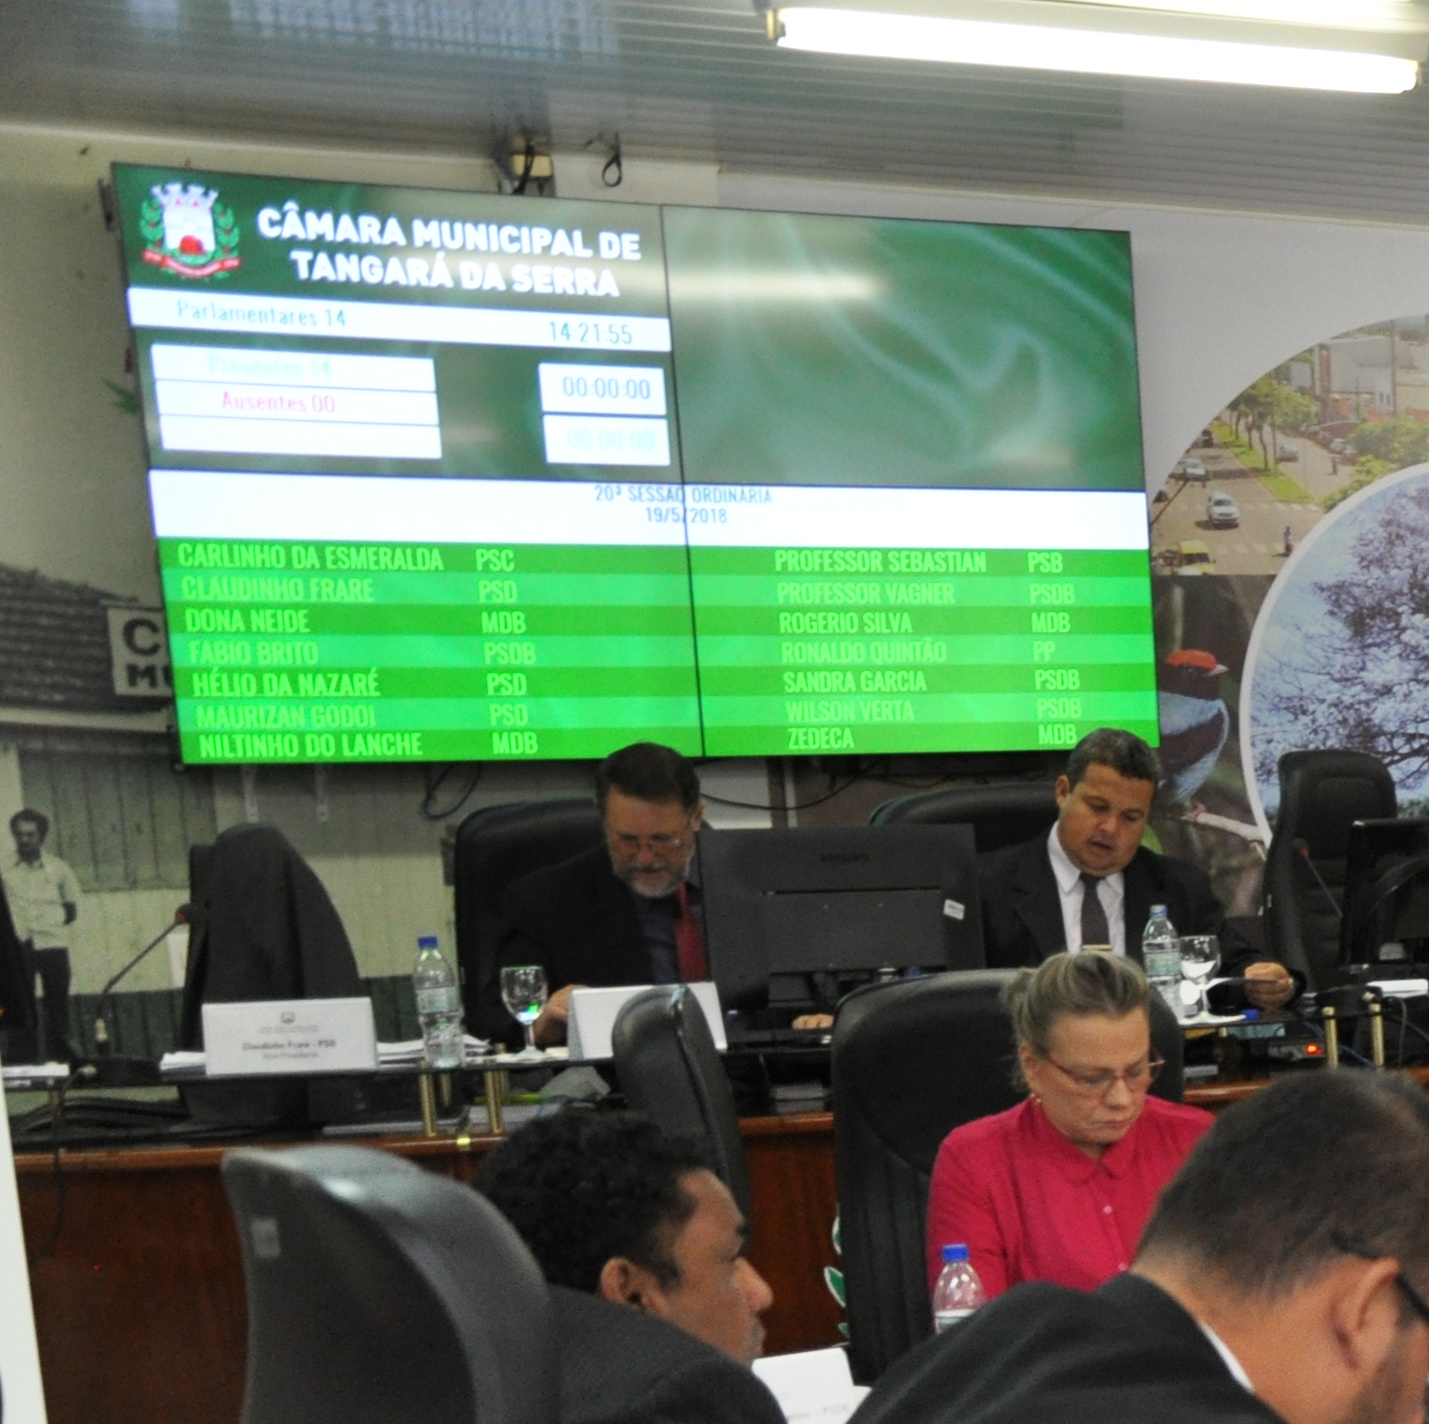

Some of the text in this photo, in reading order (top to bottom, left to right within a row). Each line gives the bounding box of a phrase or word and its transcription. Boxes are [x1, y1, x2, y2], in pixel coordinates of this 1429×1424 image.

[258, 201, 641, 261] CÂMARA MUNICIPAL DE
[290, 250, 620, 297] TANGARÁ DA SERRA
[177, 300, 346, 328] Parlamentares 14
[549, 320, 633, 346] 14:21:55
[562, 375, 651, 400] 00:00:00
[222, 390, 336, 414] Ausentes 00
[645, 507, 727, 524] 19/5/2018
[178, 543, 515, 572] CARLINHO DA ESMERALDA PSC
[774, 549, 1063, 574] PROFESSOR SEBASTIAN PSB
[181, 575, 518, 603] CLAUDINHO FRARE PSD
[776, 582, 1076, 605] PROFESSOR VAGNER PSDB
[185, 608, 526, 635] DONA NEIDE MDB
[863, 611, 913, 634] SILVA
[1031, 611, 1071, 634] MDB
[257, 641, 319, 665] BRITO
[484, 642, 536, 666] PSDB
[781, 641, 865, 664] RONALDO
[1033, 640, 1056, 662] PP
[192, 667, 527, 697] HÉLIO DA NAZARÉ PSD
[783, 668, 1080, 693] SANDRA GARCIA PSDB
[195, 704, 304, 730] MAURIZAN
[489, 703, 528, 727] PSD
[785, 697, 1082, 723] WILSON VERTA PSDB
[199, 730, 539, 760] NILTINHO DO LANCHE MDB
[787, 723, 1077, 750] ZEDECA MDB
